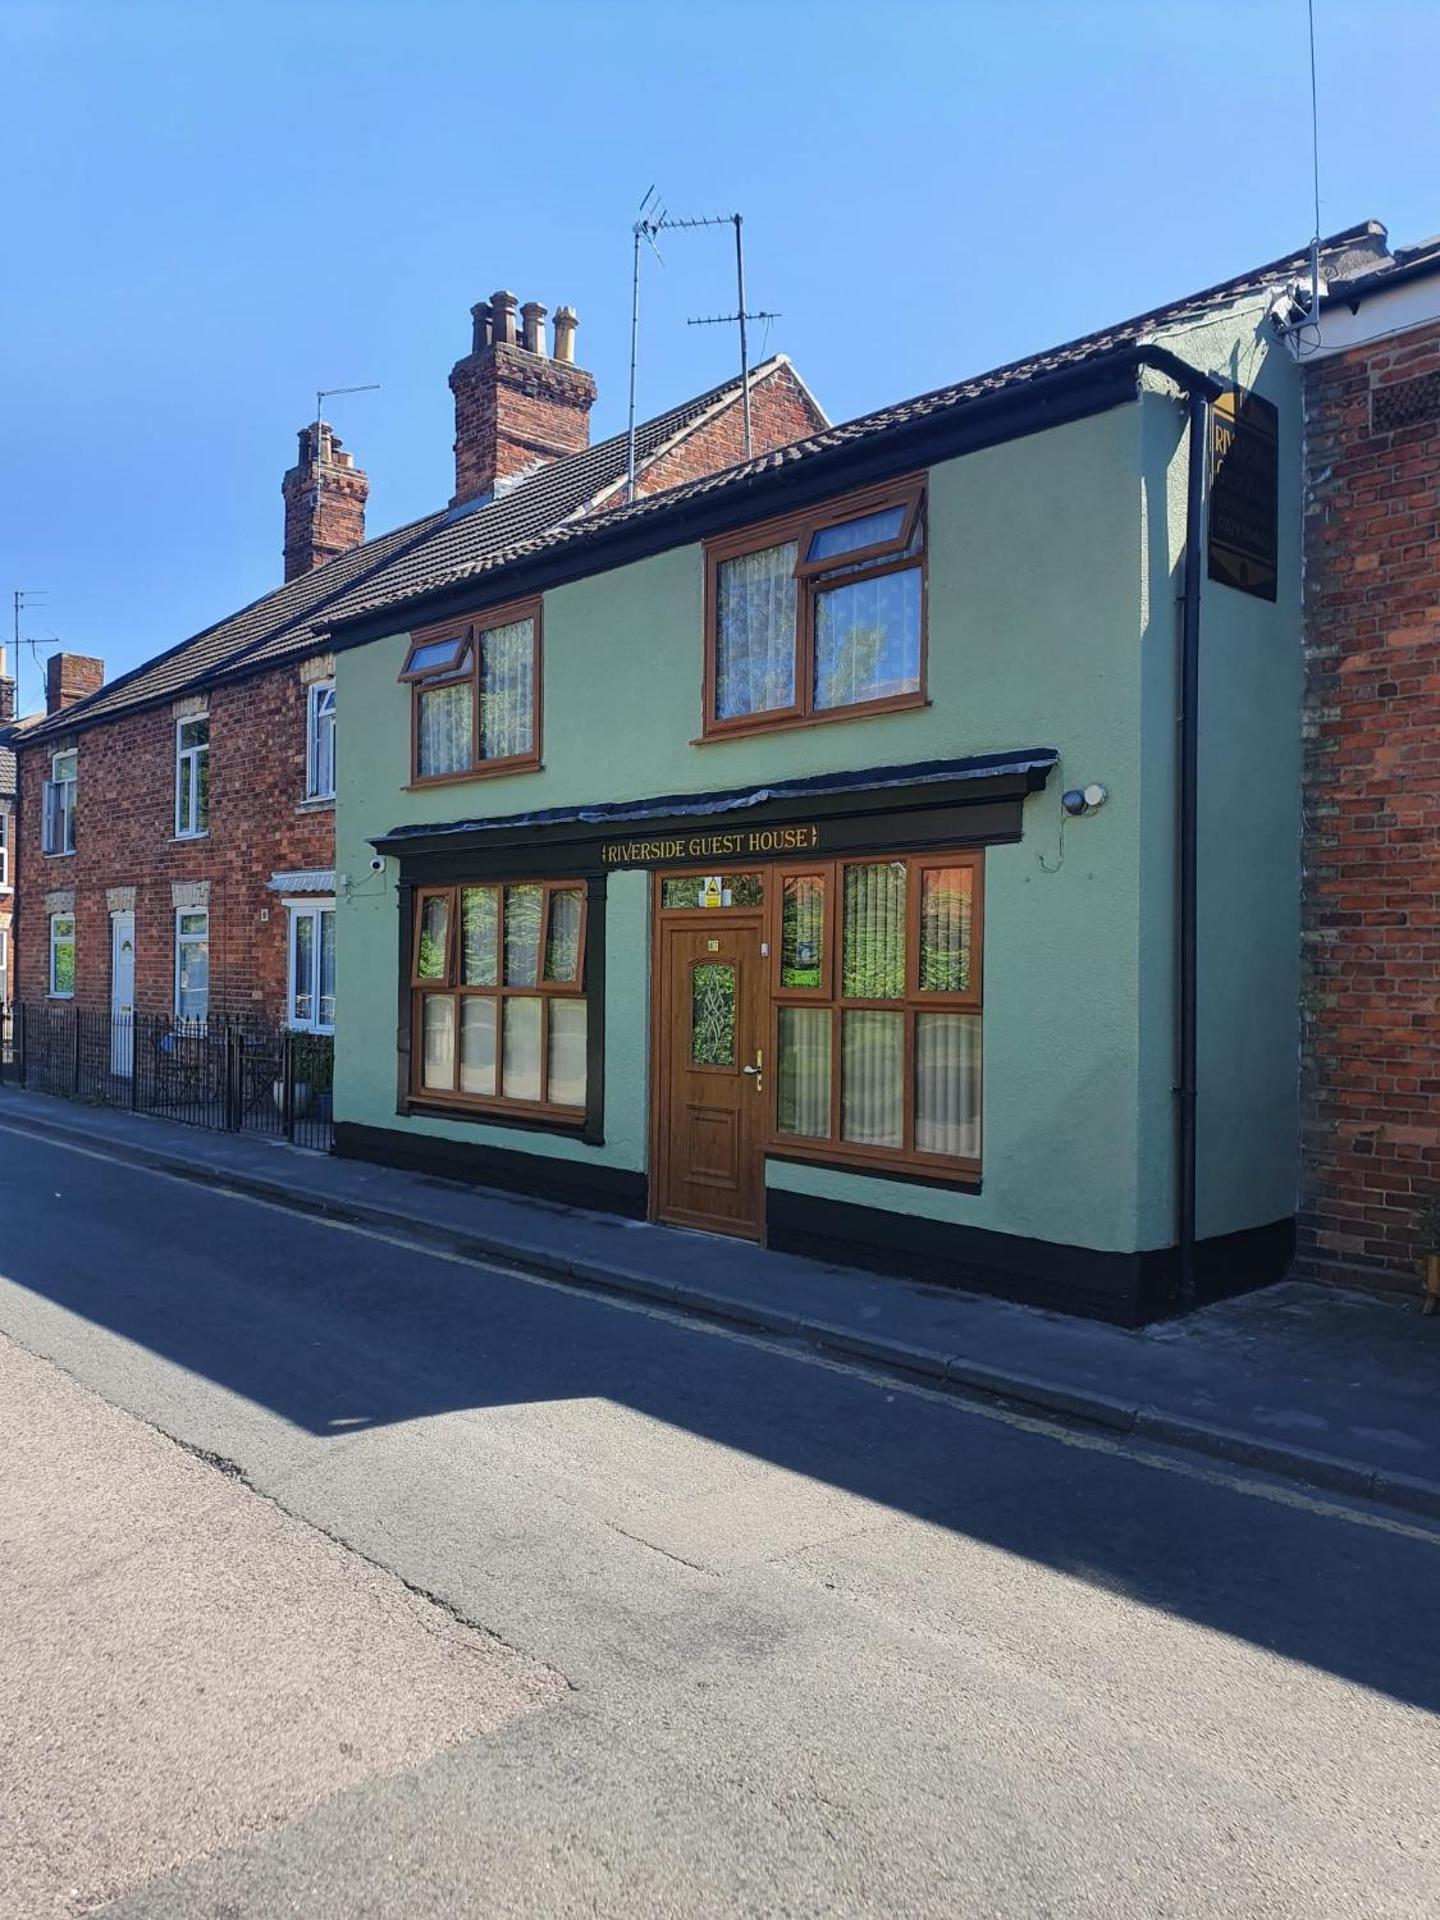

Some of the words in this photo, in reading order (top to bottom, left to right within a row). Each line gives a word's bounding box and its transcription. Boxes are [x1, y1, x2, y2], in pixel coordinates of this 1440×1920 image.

[608, 840, 685, 862] RIVERSIDE
[689, 834, 744, 856] GUEST
[750, 828, 808, 850] HOUSE
